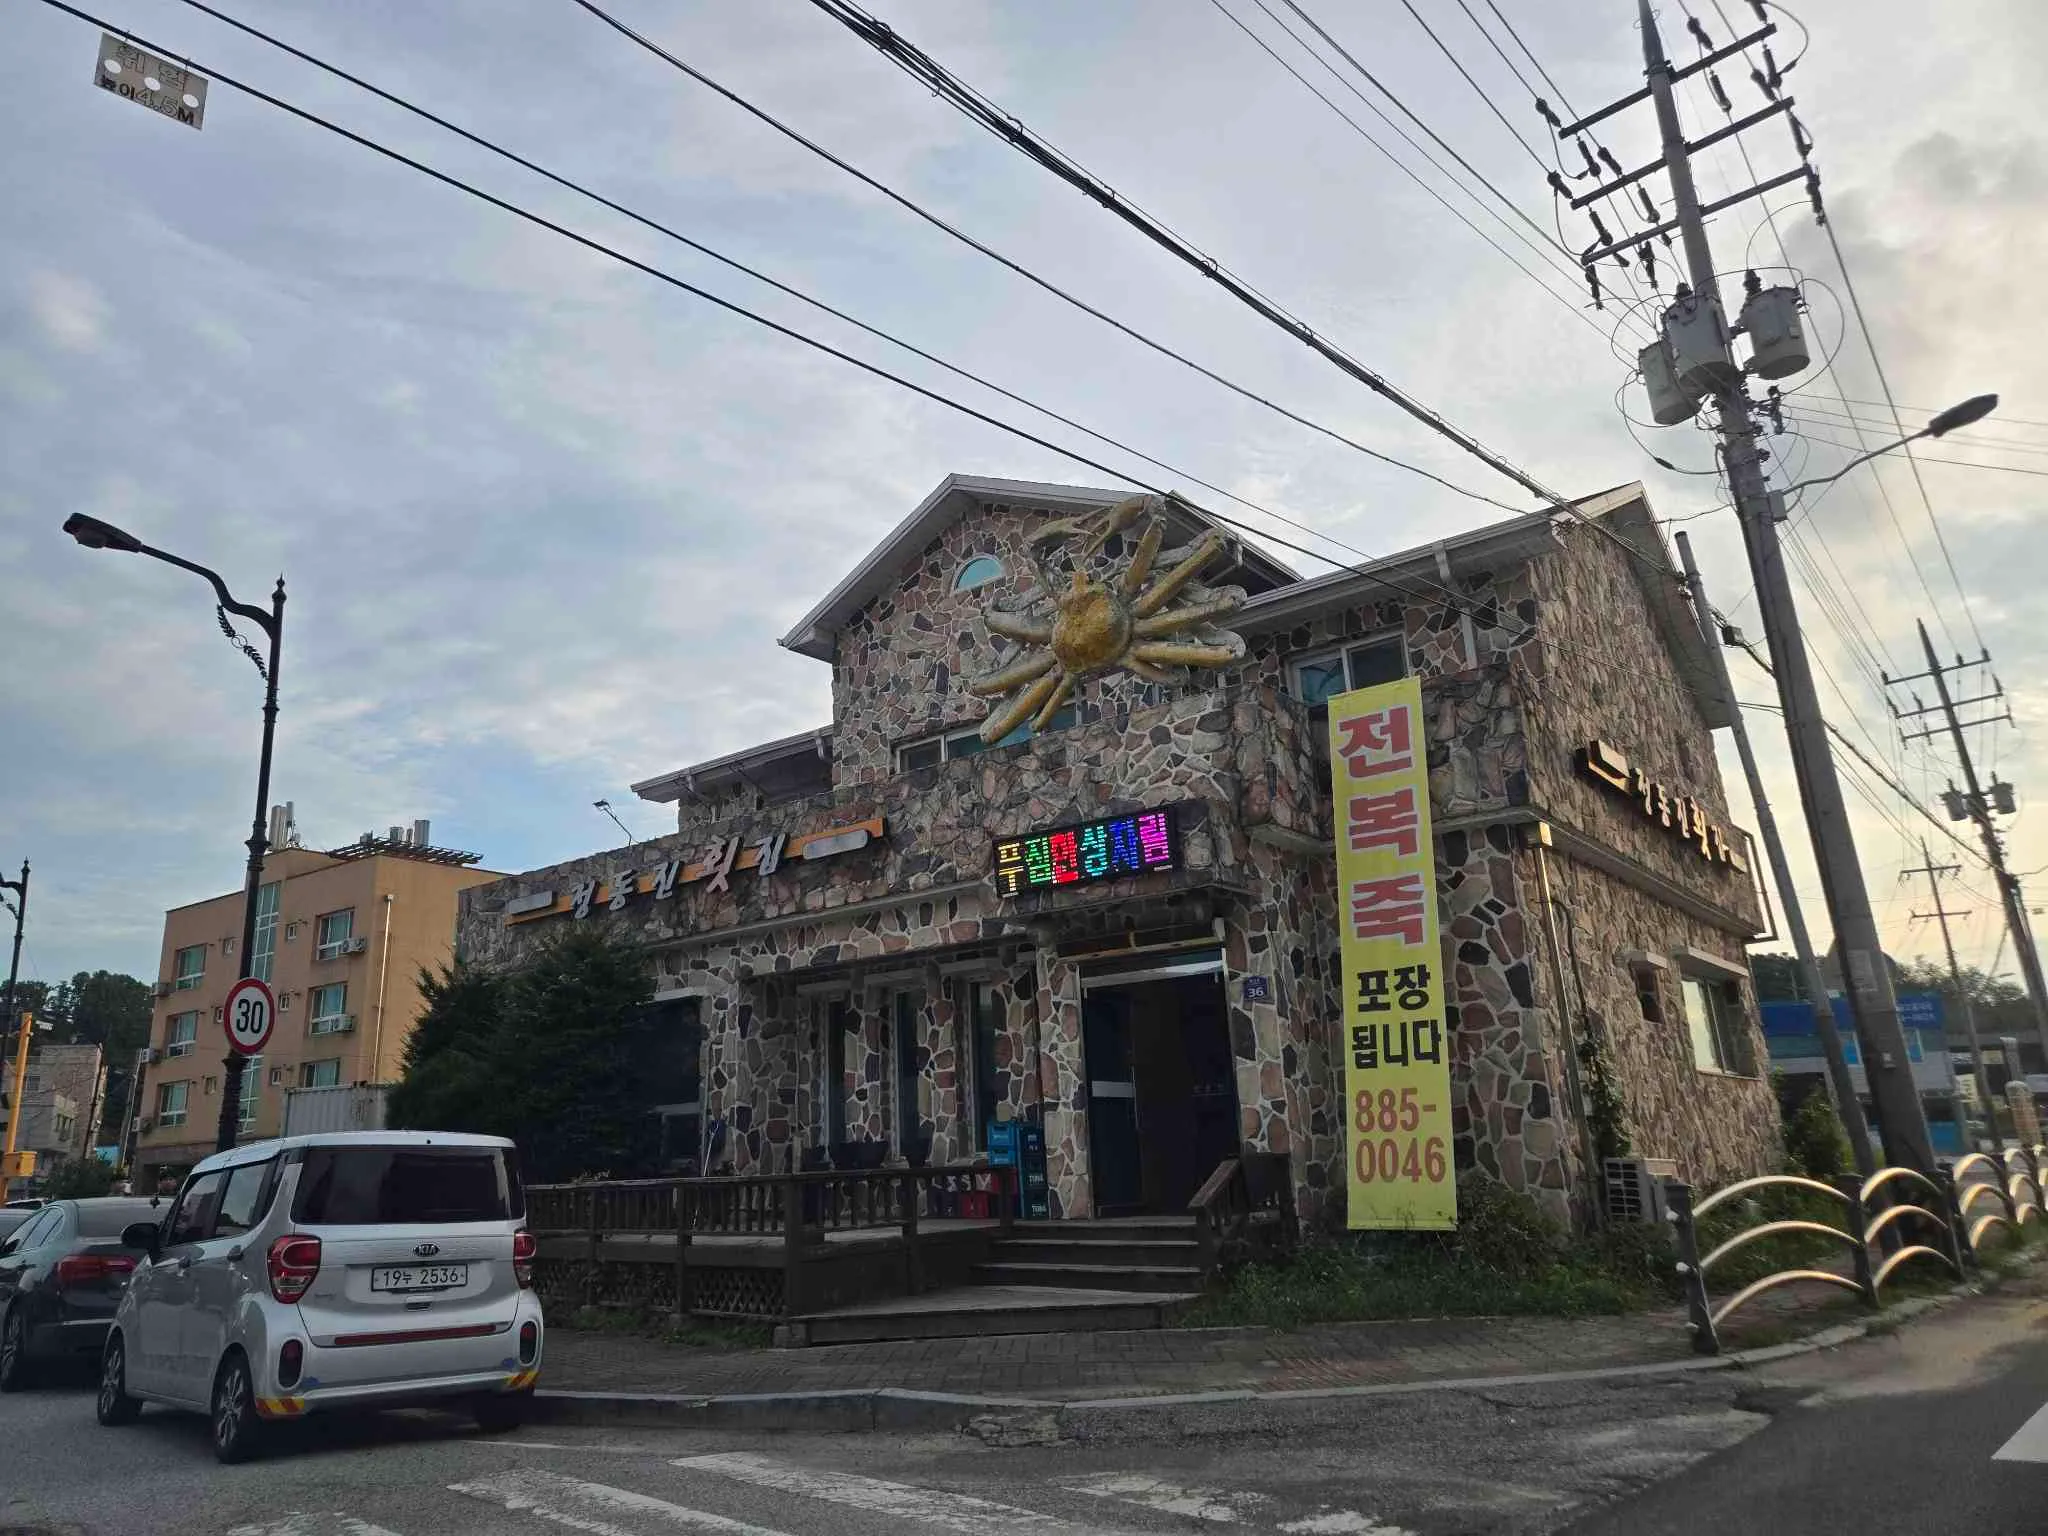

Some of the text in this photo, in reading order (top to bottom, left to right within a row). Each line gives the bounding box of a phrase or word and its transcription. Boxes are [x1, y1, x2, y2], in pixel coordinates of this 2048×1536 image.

[1337, 706, 1425, 945] 전복죽
[571, 833, 787, 919] 정동진횟집
[1247, 986, 1264, 998] 36
[1357, 963, 1431, 1013] 포장
[236, 998, 264, 1034] 30
[1351, 1018, 1442, 1070] 됩니다
[1355, 1087, 1437, 1133] 885-
[1355, 1136, 1447, 1184] 0046
[418, 1243, 438, 1256] KIA
[420, 1267, 459, 1285] 2536
